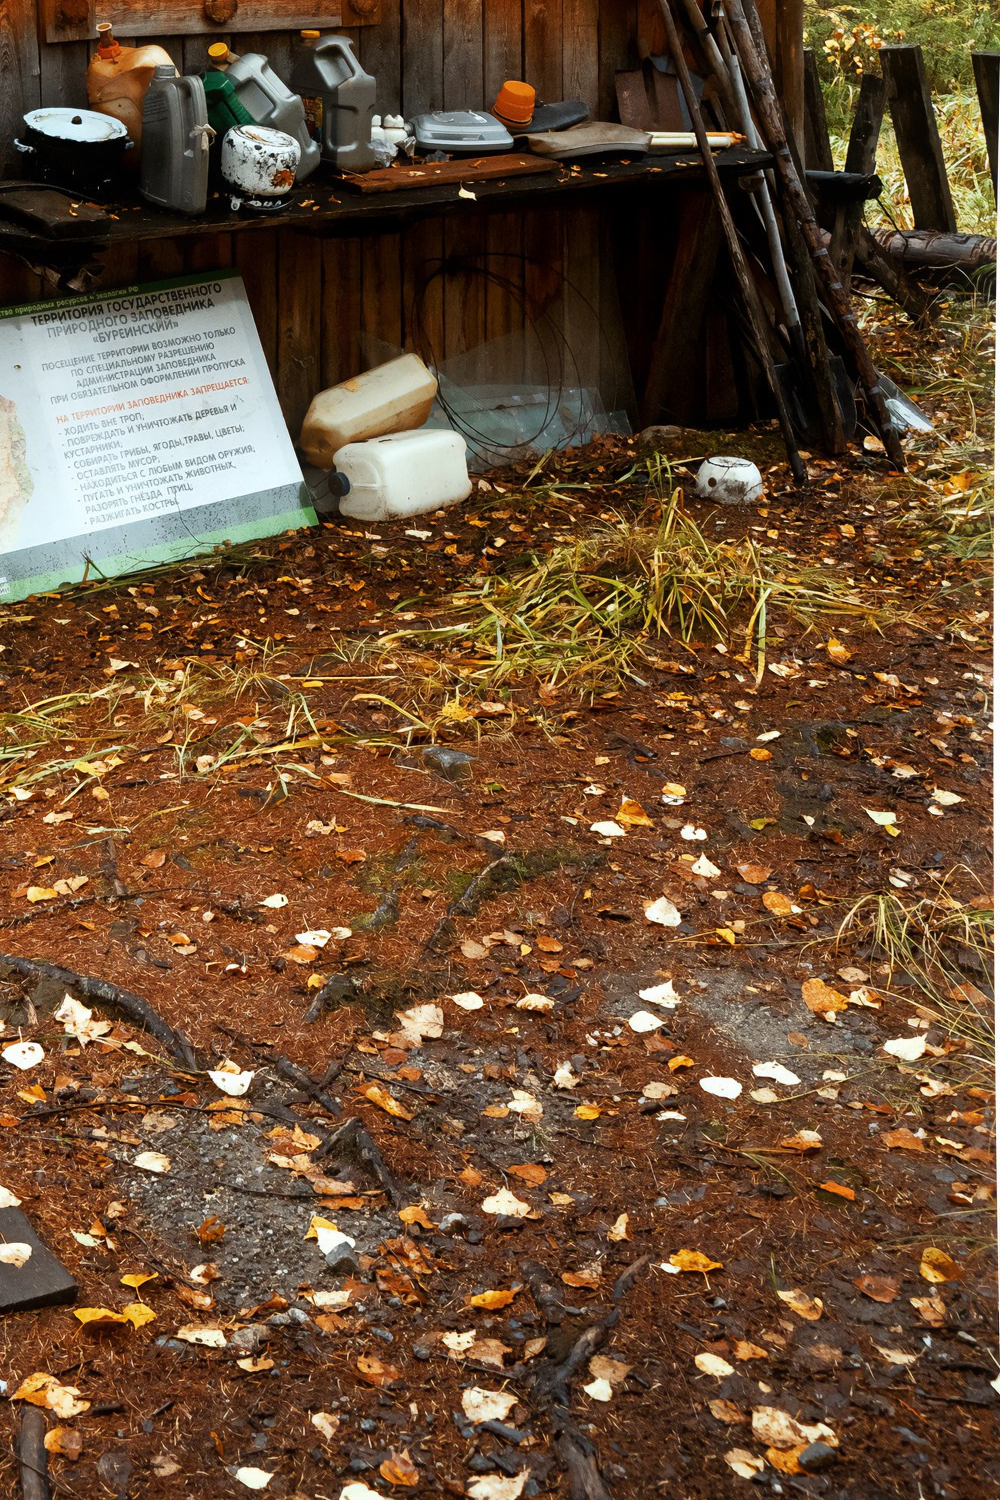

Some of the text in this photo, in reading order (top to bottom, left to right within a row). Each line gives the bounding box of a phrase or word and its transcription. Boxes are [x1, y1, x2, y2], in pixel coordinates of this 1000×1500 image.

[15, 301, 55, 315] природных
[56, 295, 88, 309] ресурсов
[31, 283, 222, 327] ТЕРРИТОРИЯ ГОСУДАРСТВЕННОГО
[47, 298, 215, 338] ПРИРОДНОГО ЗАПОВЕДНИКА
[93, 317, 179, 343] «БУРЕИНСКИЙ»
[41, 326, 236, 371] ПОСЕЩЕНИЕ ТЕРРИТОРИИ ВОЗМОЖНО ТОЛЬКО
[70, 342, 215, 377] ПО СПЕЦИАЛЬНОМУ РАЗРЕШЕНИЮ
[50, 358, 246, 405] ПРИ ОБЯЗАТЕЛЬНОМ ОФОРМЛЕНИИ ПРОПУСКА
[76, 353, 216, 388] АДМИНИСТРАЦИИ ЗАПОВЕДНИКА
[56, 415, 70, 424] НА
[71, 403, 126, 420] ТЕРРИТОРИИ
[127, 390, 189, 409] ЗАПОВЕДНИКА
[64, 422, 100, 436] ХОДИТЬ
[101, 417, 118, 428] ВНЕ
[119, 412, 145, 424] ТРОП;
[67, 428, 126, 447] ПОВРЕЖДАТЬ
[127, 425, 135, 434] И
[135, 413, 193, 432] УНИЧТОЖАТЬ
[195, 404, 229, 420] ДЕРЕВЬЯ
[230, 403, 237, 411] И
[73, 453, 119, 469] СОБИРАТЬ
[120, 446, 151, 459] ГРИБЫ,
[215, 424, 245, 438] ЦВЕТЫ;
[76, 463, 126, 480] ОСТАВЛЯТЬ
[80, 471, 138, 491] НАХОДИТЬСЯ
[139, 469, 146, 478] С
[148, 461, 183, 476] ЛЮБЫМ
[184, 453, 217, 467] ВИДОМ
[217, 444, 256, 460] ОРУЖИЯ;
[83, 489, 115, 502] ПУГАТЬ
[116, 486, 124, 495] И
[125, 473, 183, 493] УНИЧТОЖАТЬ
[85, 497, 129, 514] РАЗОРЯТЬ
[89, 507, 142, 525] РАЗЖИГАТЬ
